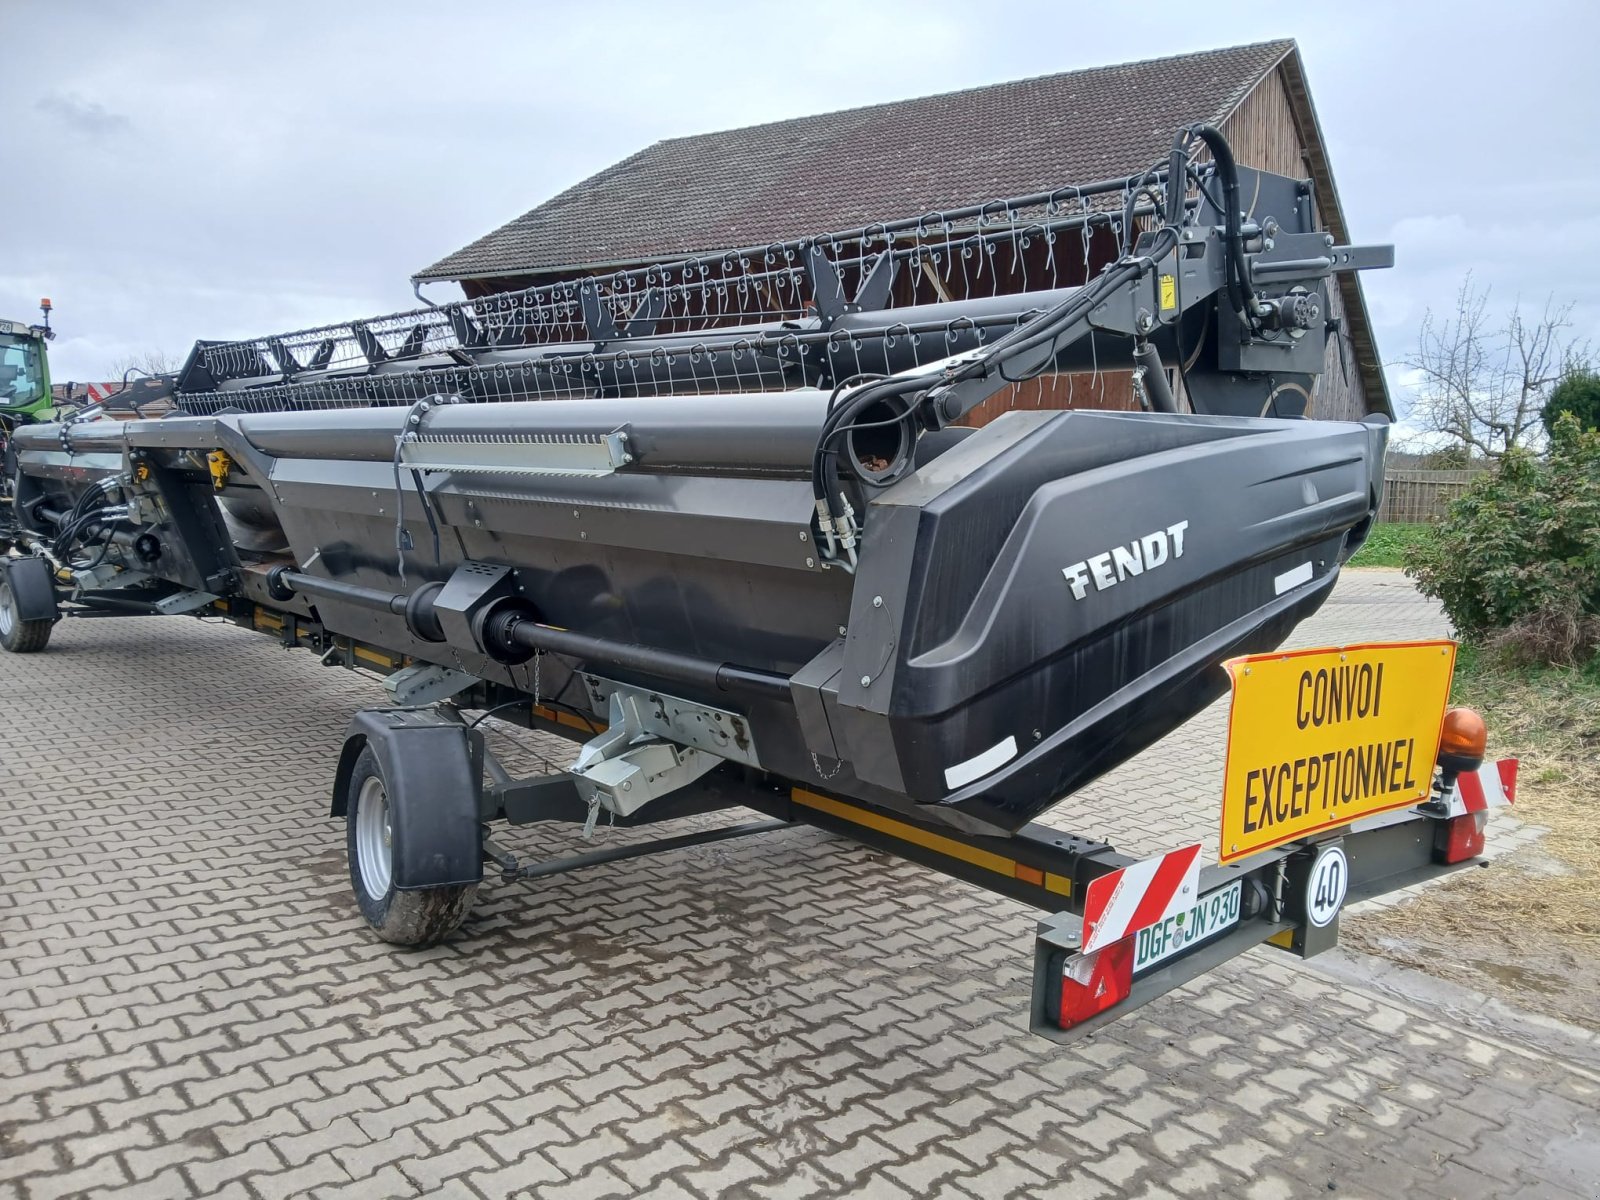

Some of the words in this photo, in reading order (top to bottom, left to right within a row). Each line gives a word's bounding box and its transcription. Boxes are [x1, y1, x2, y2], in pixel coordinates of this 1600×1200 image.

[1061, 520, 1188, 600] FENDT
[1296, 662, 1384, 730] CONVOI
[1243, 738, 1416, 834] EXCEPTIONNEL
[1137, 916, 1175, 966] DGF
[1184, 902, 1208, 942] JN
[1210, 886, 1239, 931] 930
[1314, 860, 1340, 912] 40
